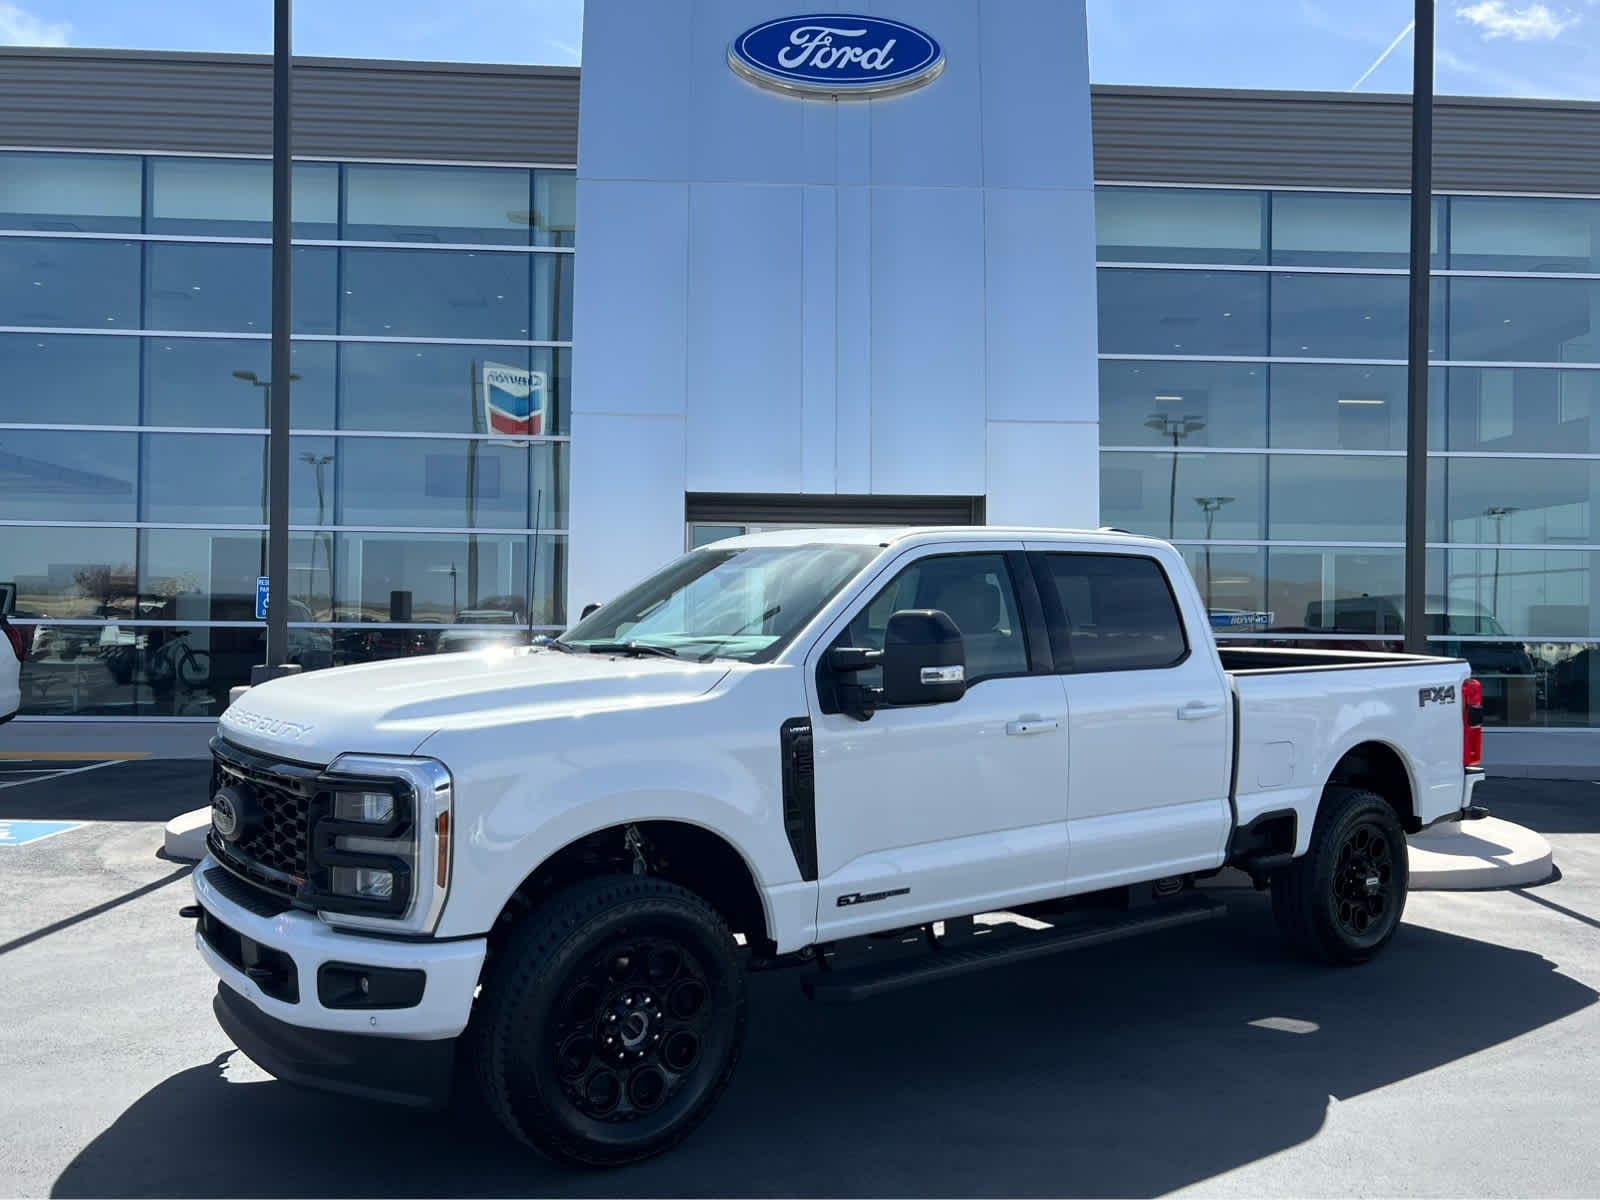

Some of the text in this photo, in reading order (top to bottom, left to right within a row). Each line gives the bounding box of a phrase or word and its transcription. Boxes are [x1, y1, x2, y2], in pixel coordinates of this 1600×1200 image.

[777, 26, 897, 70] Ford
[1418, 685, 1456, 707] FX4
[256, 716, 316, 741] DUTY
